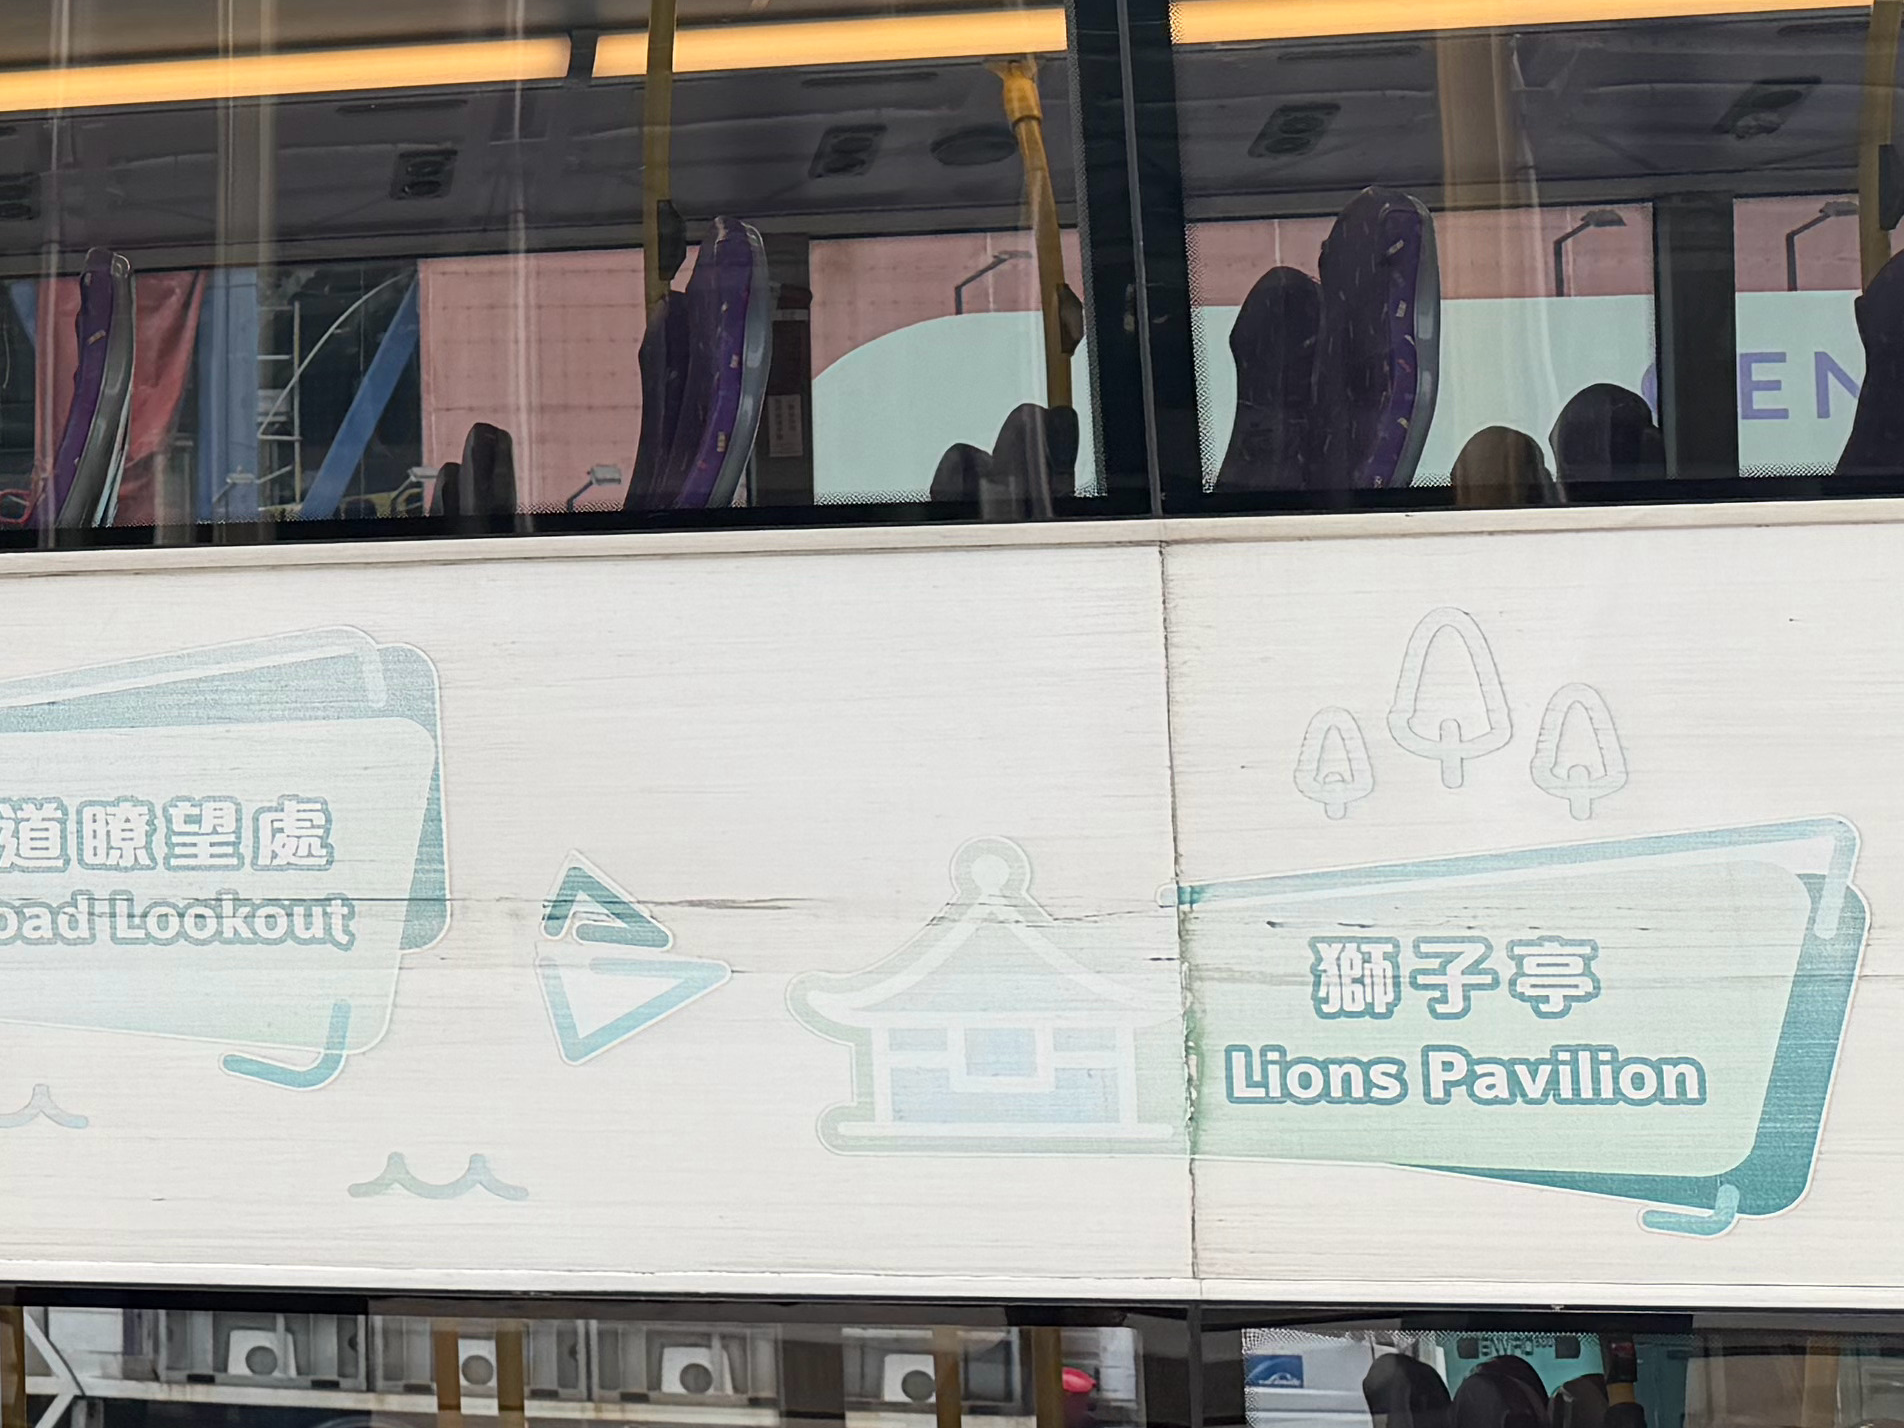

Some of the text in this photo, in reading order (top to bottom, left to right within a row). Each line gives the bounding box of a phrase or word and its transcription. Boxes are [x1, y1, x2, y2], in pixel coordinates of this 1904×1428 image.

[109, 890, 355, 951] Lookout
[1311, 938, 1602, 1018] 獅子亭
[1227, 1044, 1706, 1106] Lions Pavilion
